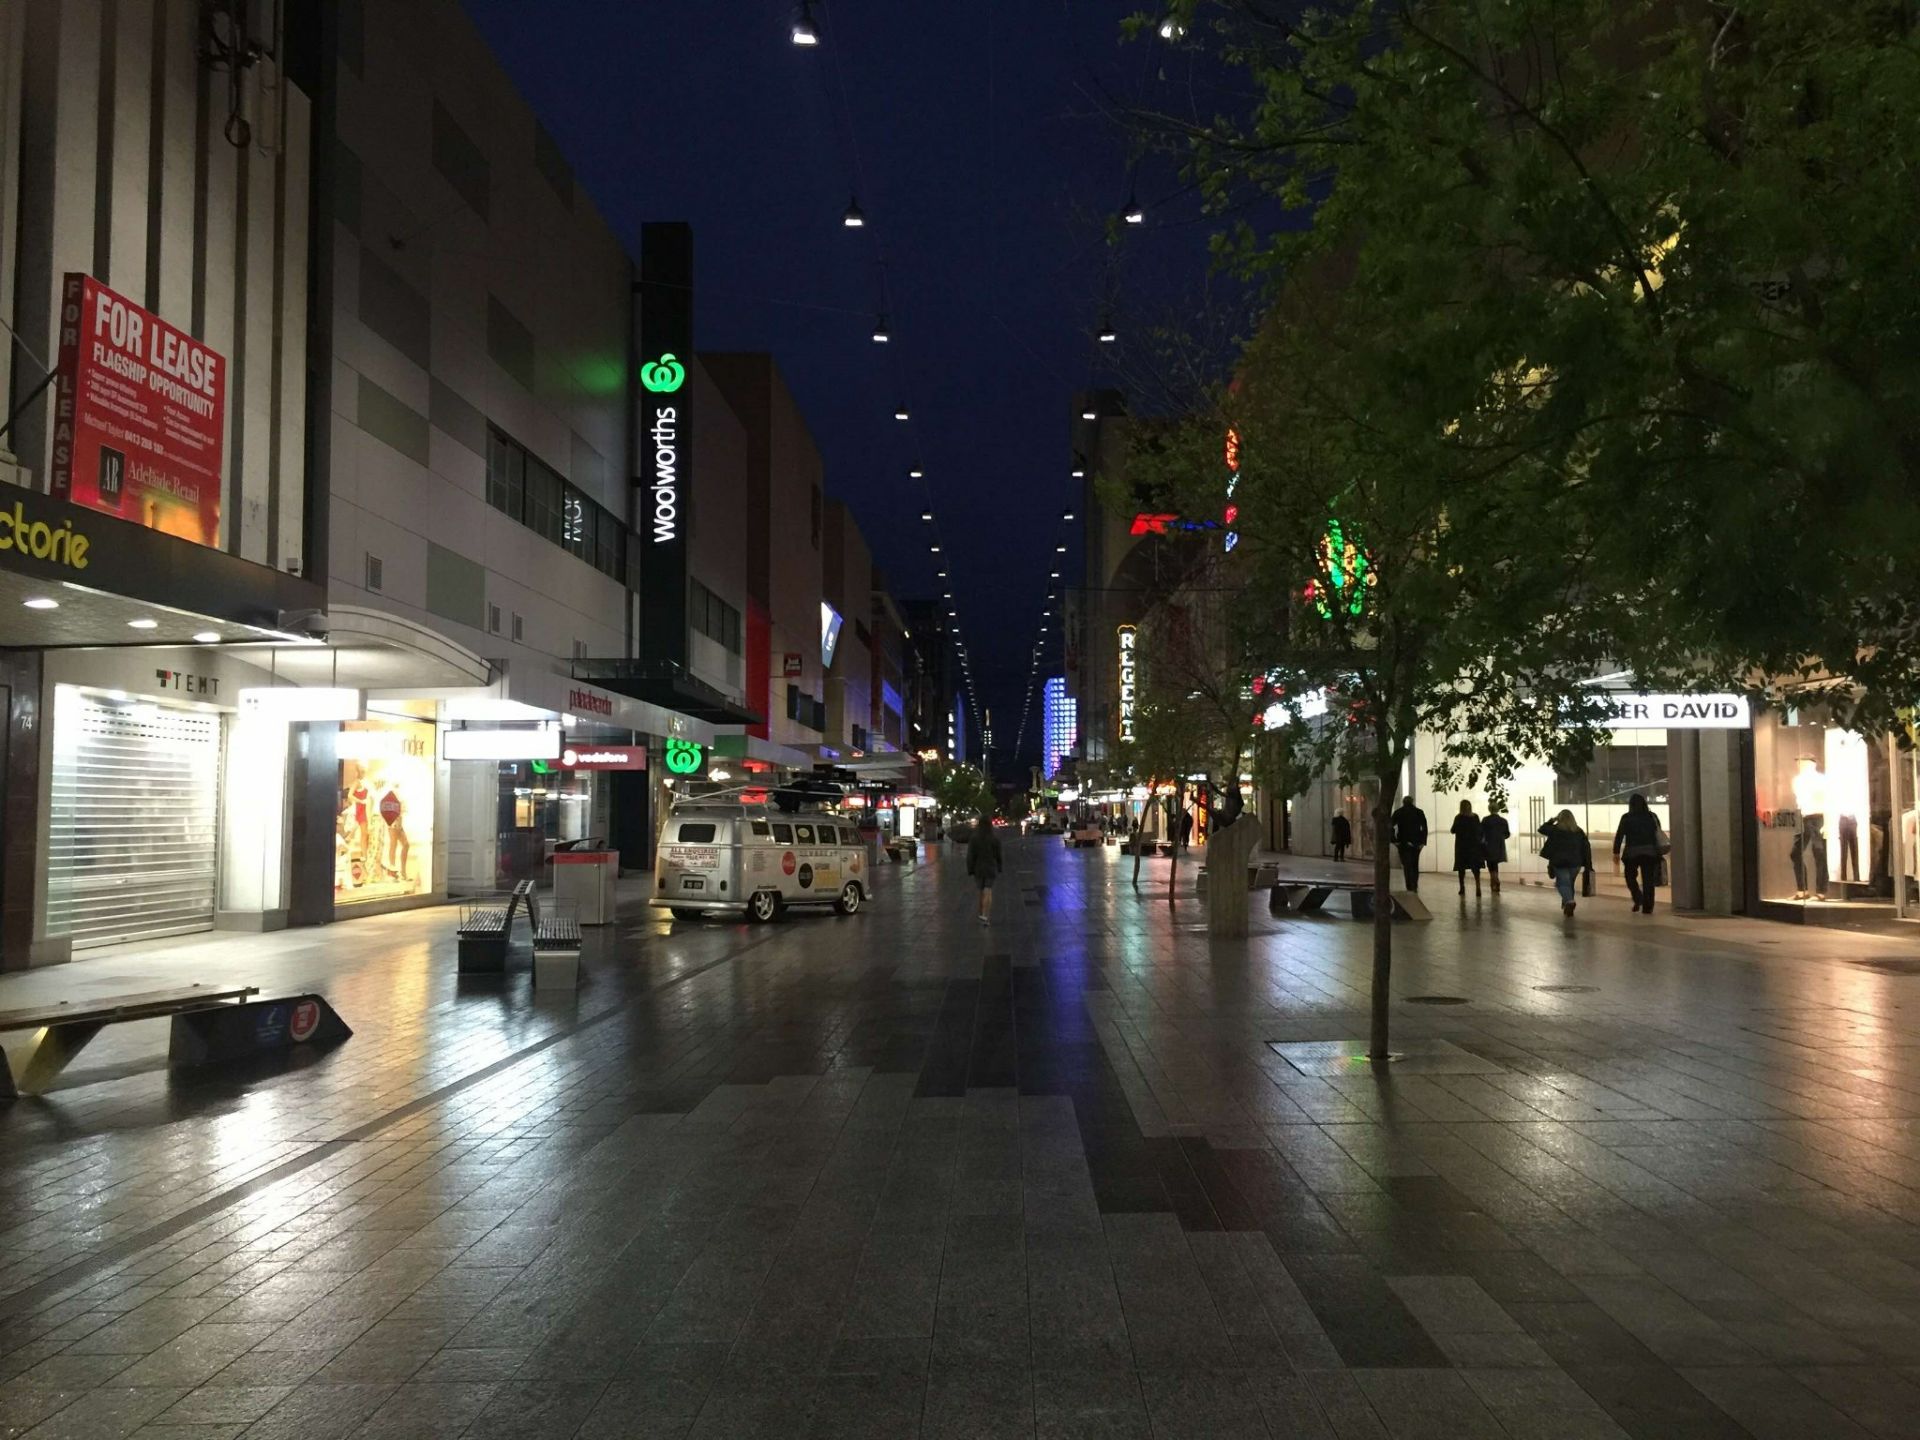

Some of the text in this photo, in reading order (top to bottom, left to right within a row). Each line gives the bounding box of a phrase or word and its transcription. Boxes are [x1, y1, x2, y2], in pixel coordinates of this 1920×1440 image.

[93, 341, 147, 384] FLAGSHIP
[149, 370, 215, 420] OPPORTUNITY
[94, 291, 216, 397] FOR LEASE
[54, 280, 80, 490] FOR LEASE
[127, 460, 173, 494] Adelaide
[173, 476, 200, 505] Retail
[650, 405, 676, 543] Woolworths
[20, 714, 33, 730] 74
[1120, 631, 1136, 736] REGENT
[1663, 702, 1738, 719] DAVID
[578, 751, 629, 763] vodafone
